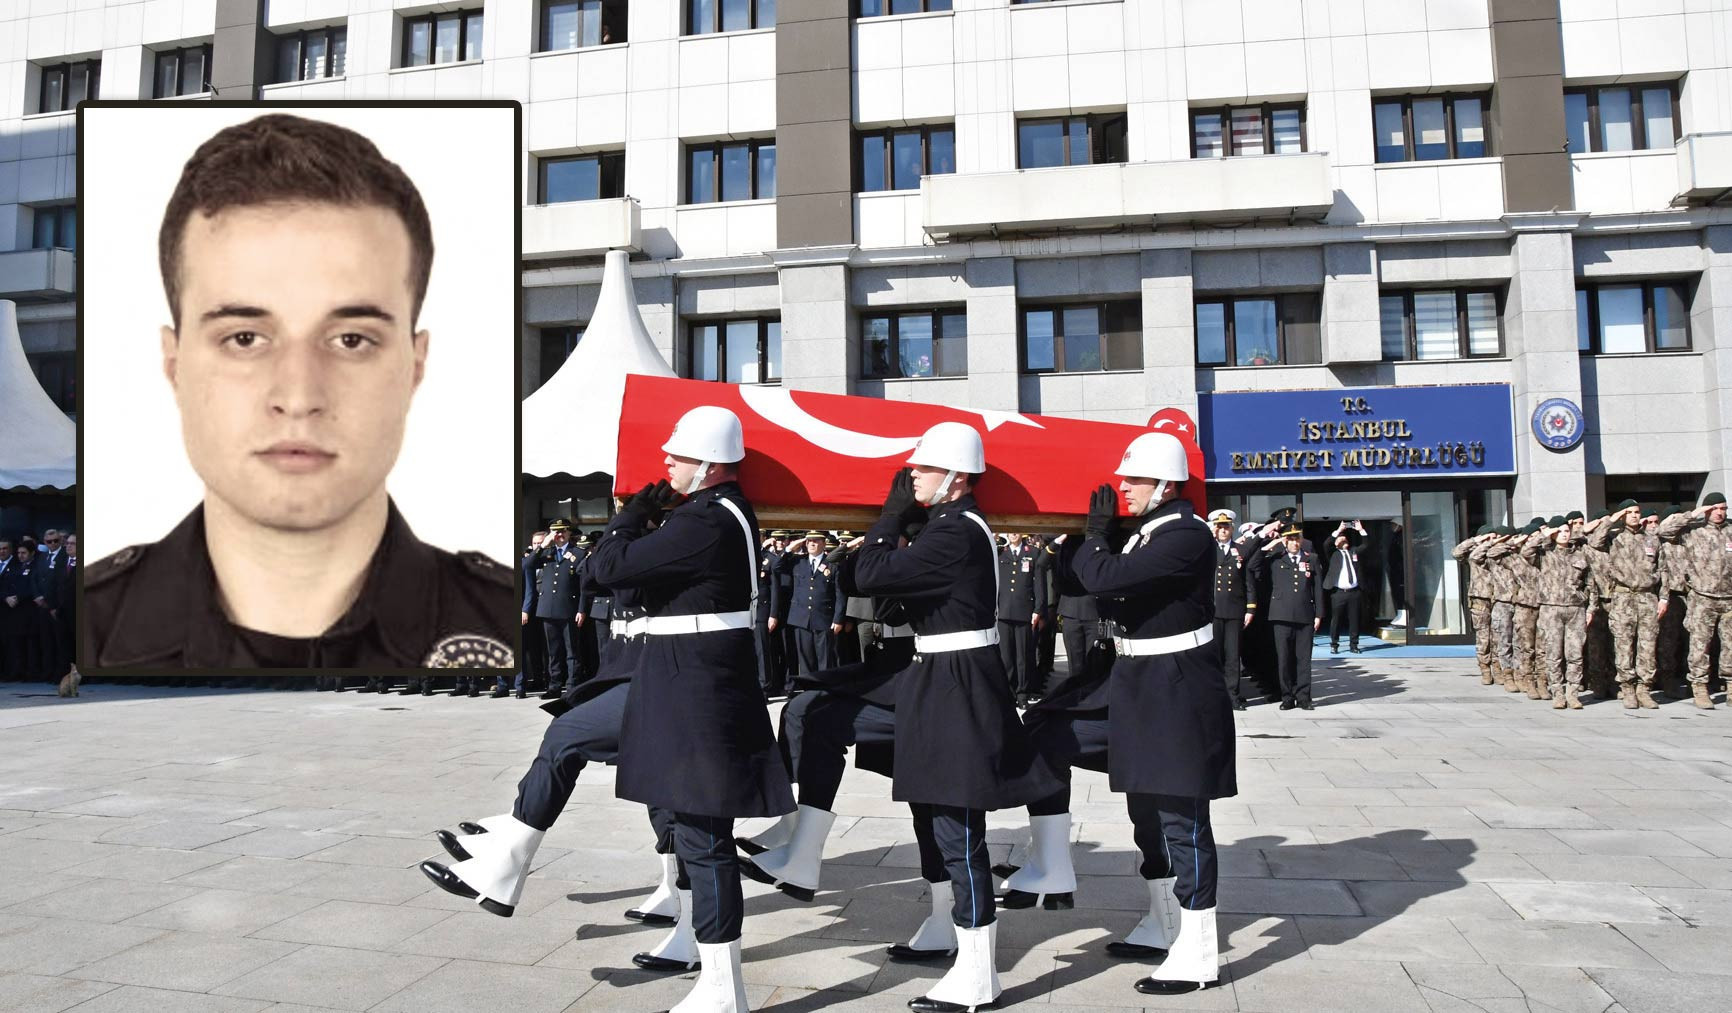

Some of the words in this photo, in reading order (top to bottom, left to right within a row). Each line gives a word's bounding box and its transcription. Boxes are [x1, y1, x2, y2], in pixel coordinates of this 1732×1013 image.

[1340, 397, 1372, 412] T.C.
[1298, 417, 1412, 441] İSTANBUL
[1229, 446, 1334, 470] EMNİYET
[1341, 441, 1485, 468] MÜDÜRLÜĞÜ
